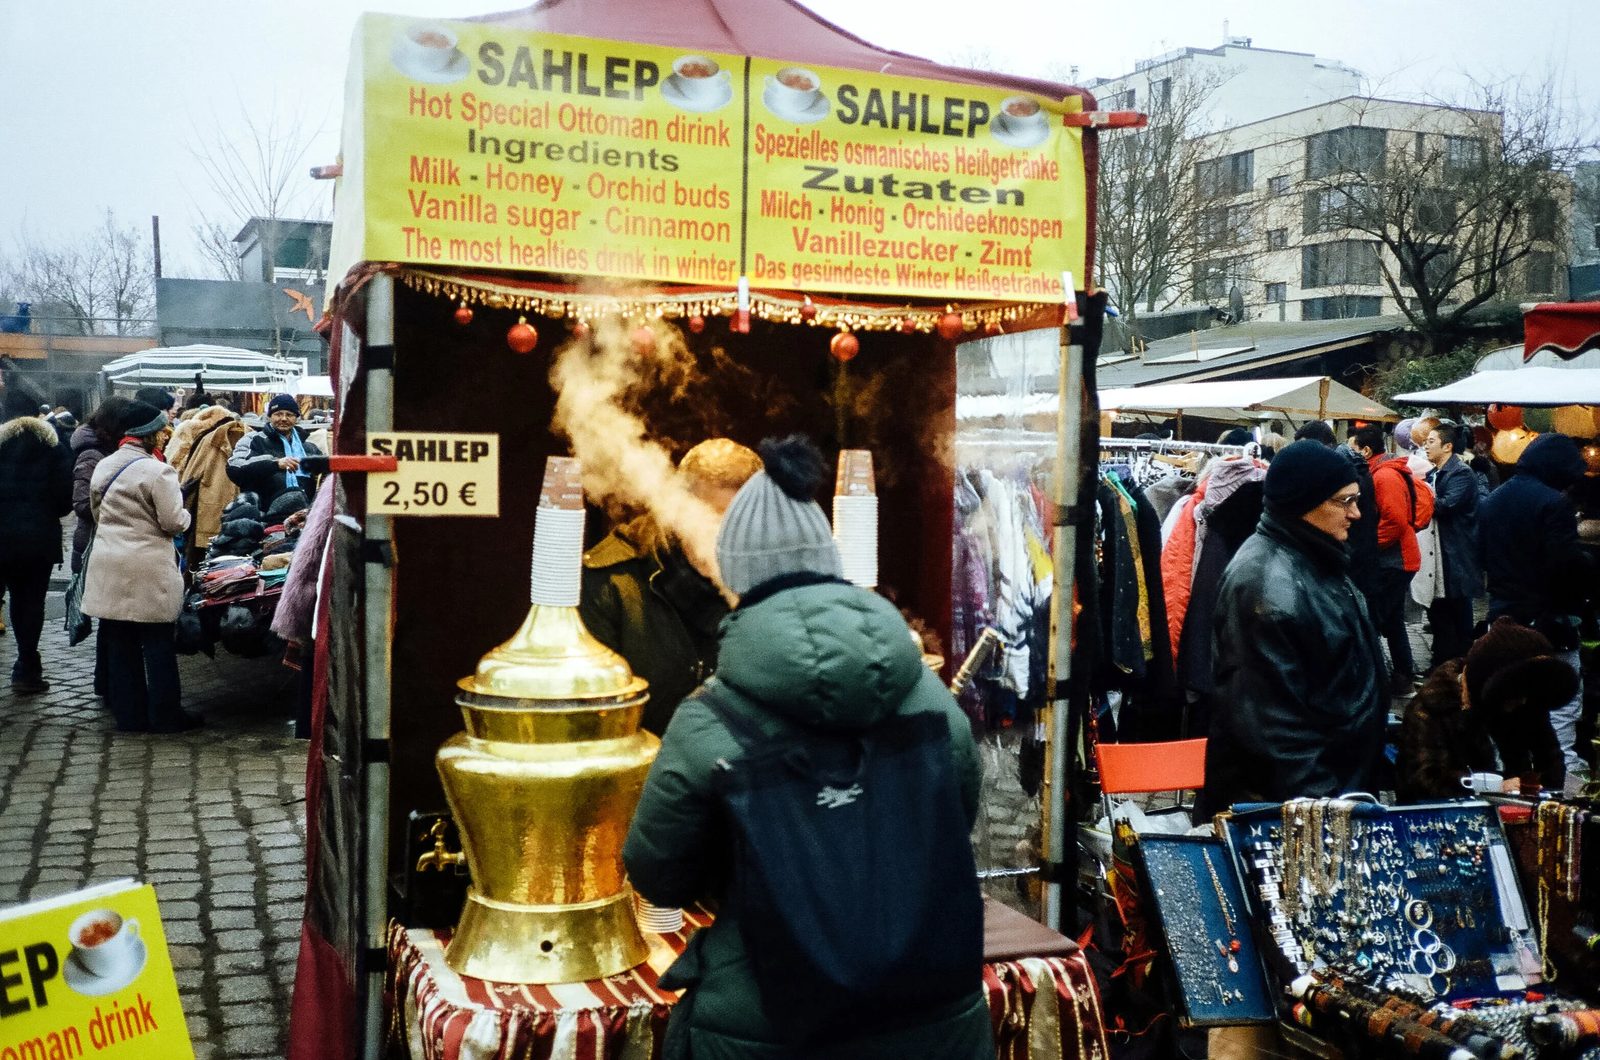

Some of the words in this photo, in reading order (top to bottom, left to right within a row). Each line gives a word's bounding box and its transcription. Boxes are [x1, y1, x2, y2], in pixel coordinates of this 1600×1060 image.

[477, 41, 660, 101] SAHLEP
[409, 87, 452, 120] Hot
[460, 91, 549, 130] Special
[558, 102, 658, 140] Ottoman
[666, 114, 730, 147] dirink
[836, 83, 990, 138] SAHLEP
[468, 128, 679, 172] Ingredients
[755, 123, 838, 163] Spezielles
[844, 140, 949, 173] osmanisches
[954, 145, 1059, 186] Heißgetränke
[410, 155, 460, 186] Milk
[486, 162, 564, 202] Honey
[587, 172, 666, 204] Orchid
[674, 179, 730, 210] buds
[802, 165, 1024, 206] Zutaten
[408, 189, 497, 224] Vanilla
[507, 204, 581, 236] sugar
[605, 206, 730, 242] Cinnamon
[760, 189, 812, 221] Milch
[831, 195, 885, 234] Honig
[903, 202, 1063, 243] Orchideeknospen
[402, 226, 442, 260] The
[450, 236, 502, 263] most
[509, 235, 589, 270] healties
[596, 243, 646, 275] drink
[653, 247, 670, 277] in
[676, 250, 736, 281] winter
[792, 226, 959, 263] Vanillezucker
[979, 239, 1032, 268] Zimt
[754, 253, 786, 280] Das
[792, 259, 890, 287] gesündeste
[896, 263, 949, 290] Winter
[954, 266, 1061, 297] Heißgetränke
[371, 438, 489, 463] SAHLEP
[383, 481, 448, 510] 2,50
[458, 482, 477, 506] €
[88, 993, 158, 1050] drink
